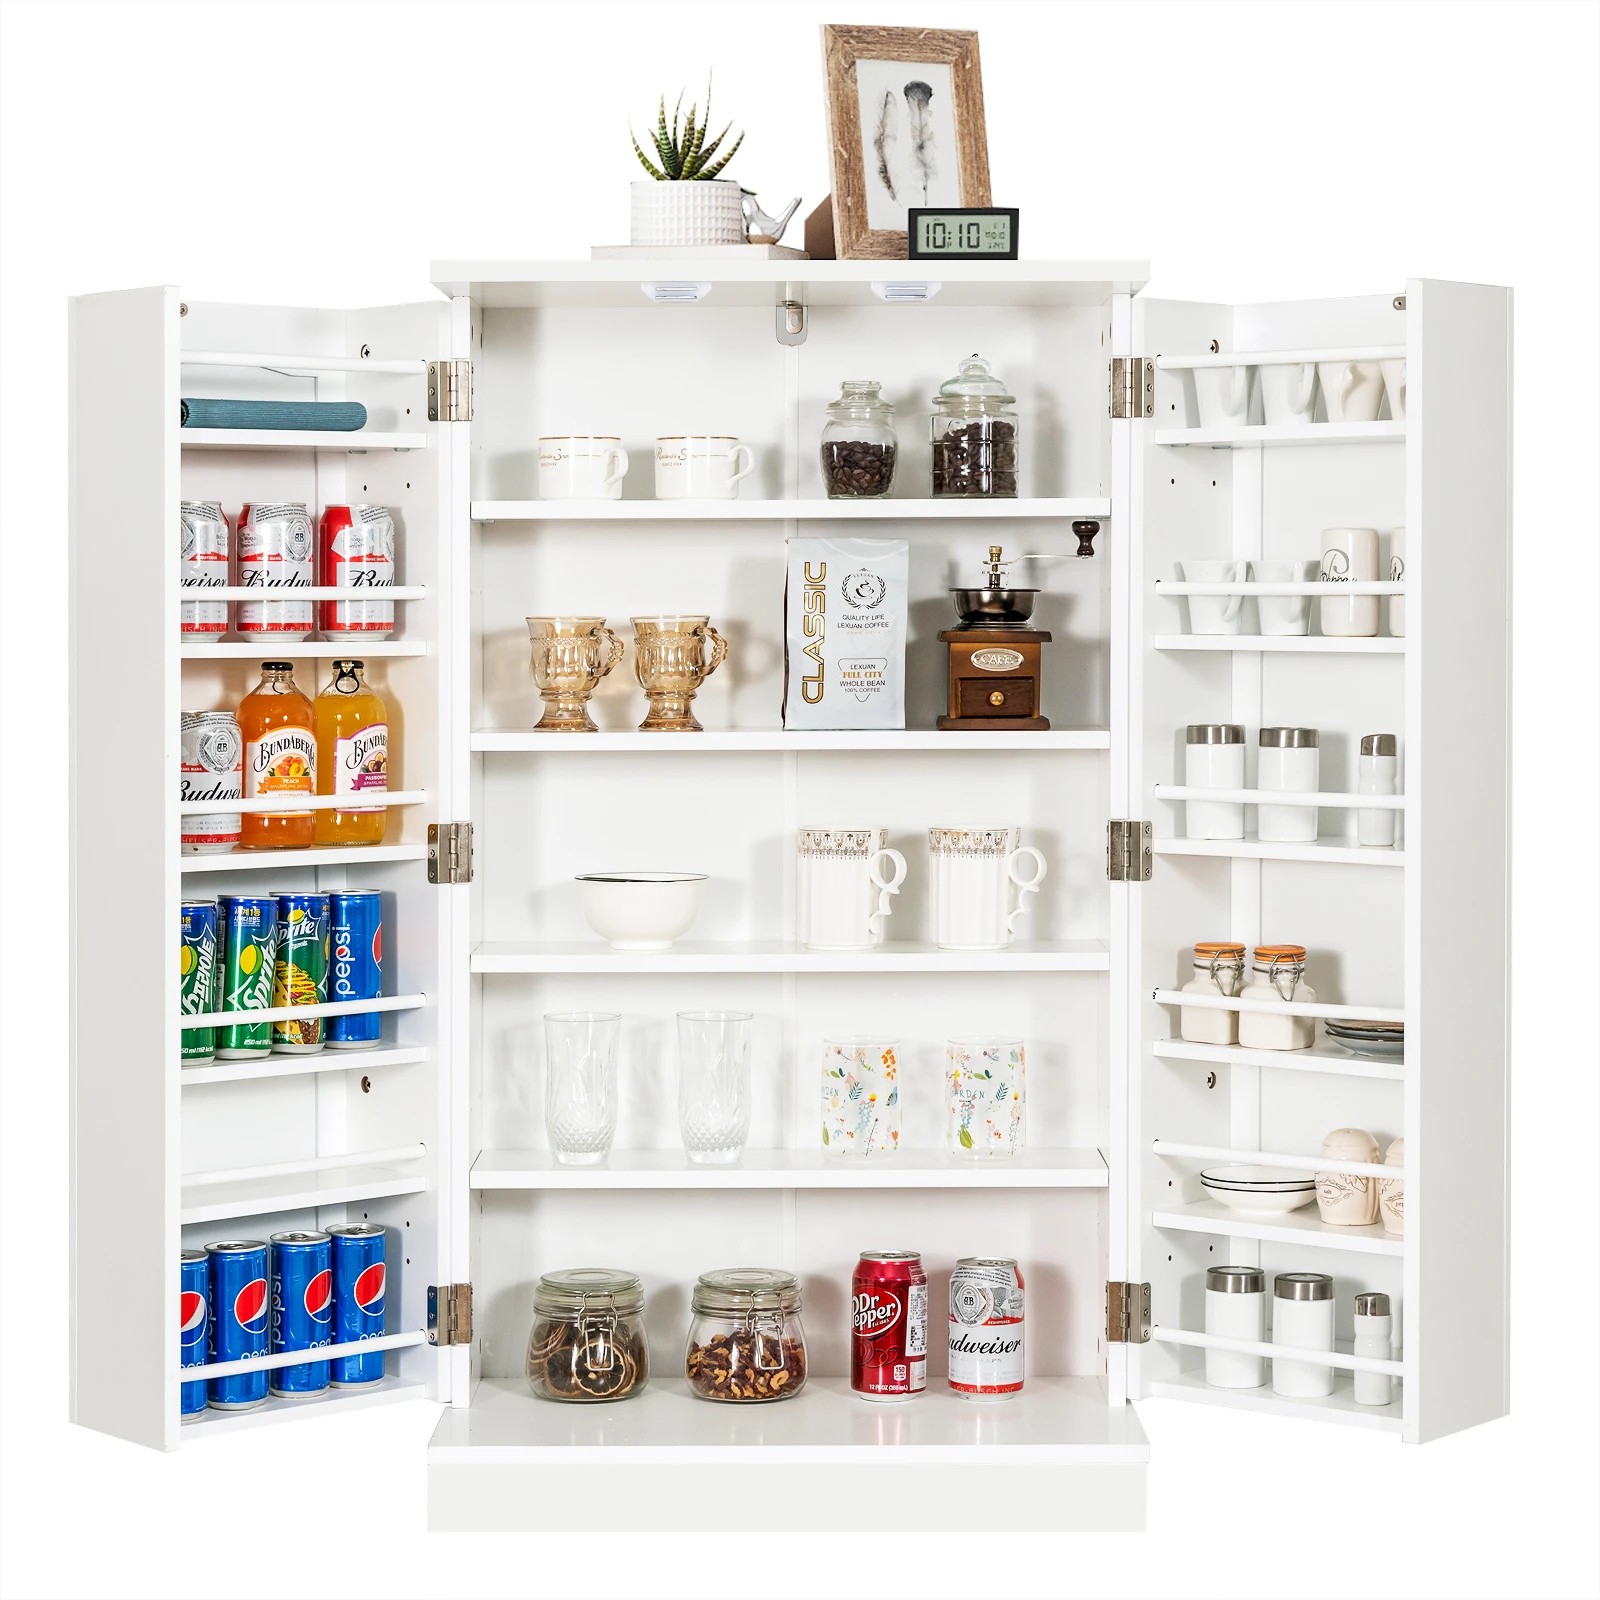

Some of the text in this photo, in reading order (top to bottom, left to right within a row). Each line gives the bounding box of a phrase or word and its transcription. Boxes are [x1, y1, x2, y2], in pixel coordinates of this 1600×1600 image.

[926, 223, 980, 248] 10:10
[802, 562, 826, 704] CLASSIC
[253, 735, 316, 773] BUNDABERG
[243, 938, 277, 1012] Sprite
[332, 926, 356, 995] pepsi
[859, 1292, 880, 1314] Dr
[949, 1333, 1021, 1354] udweiser
